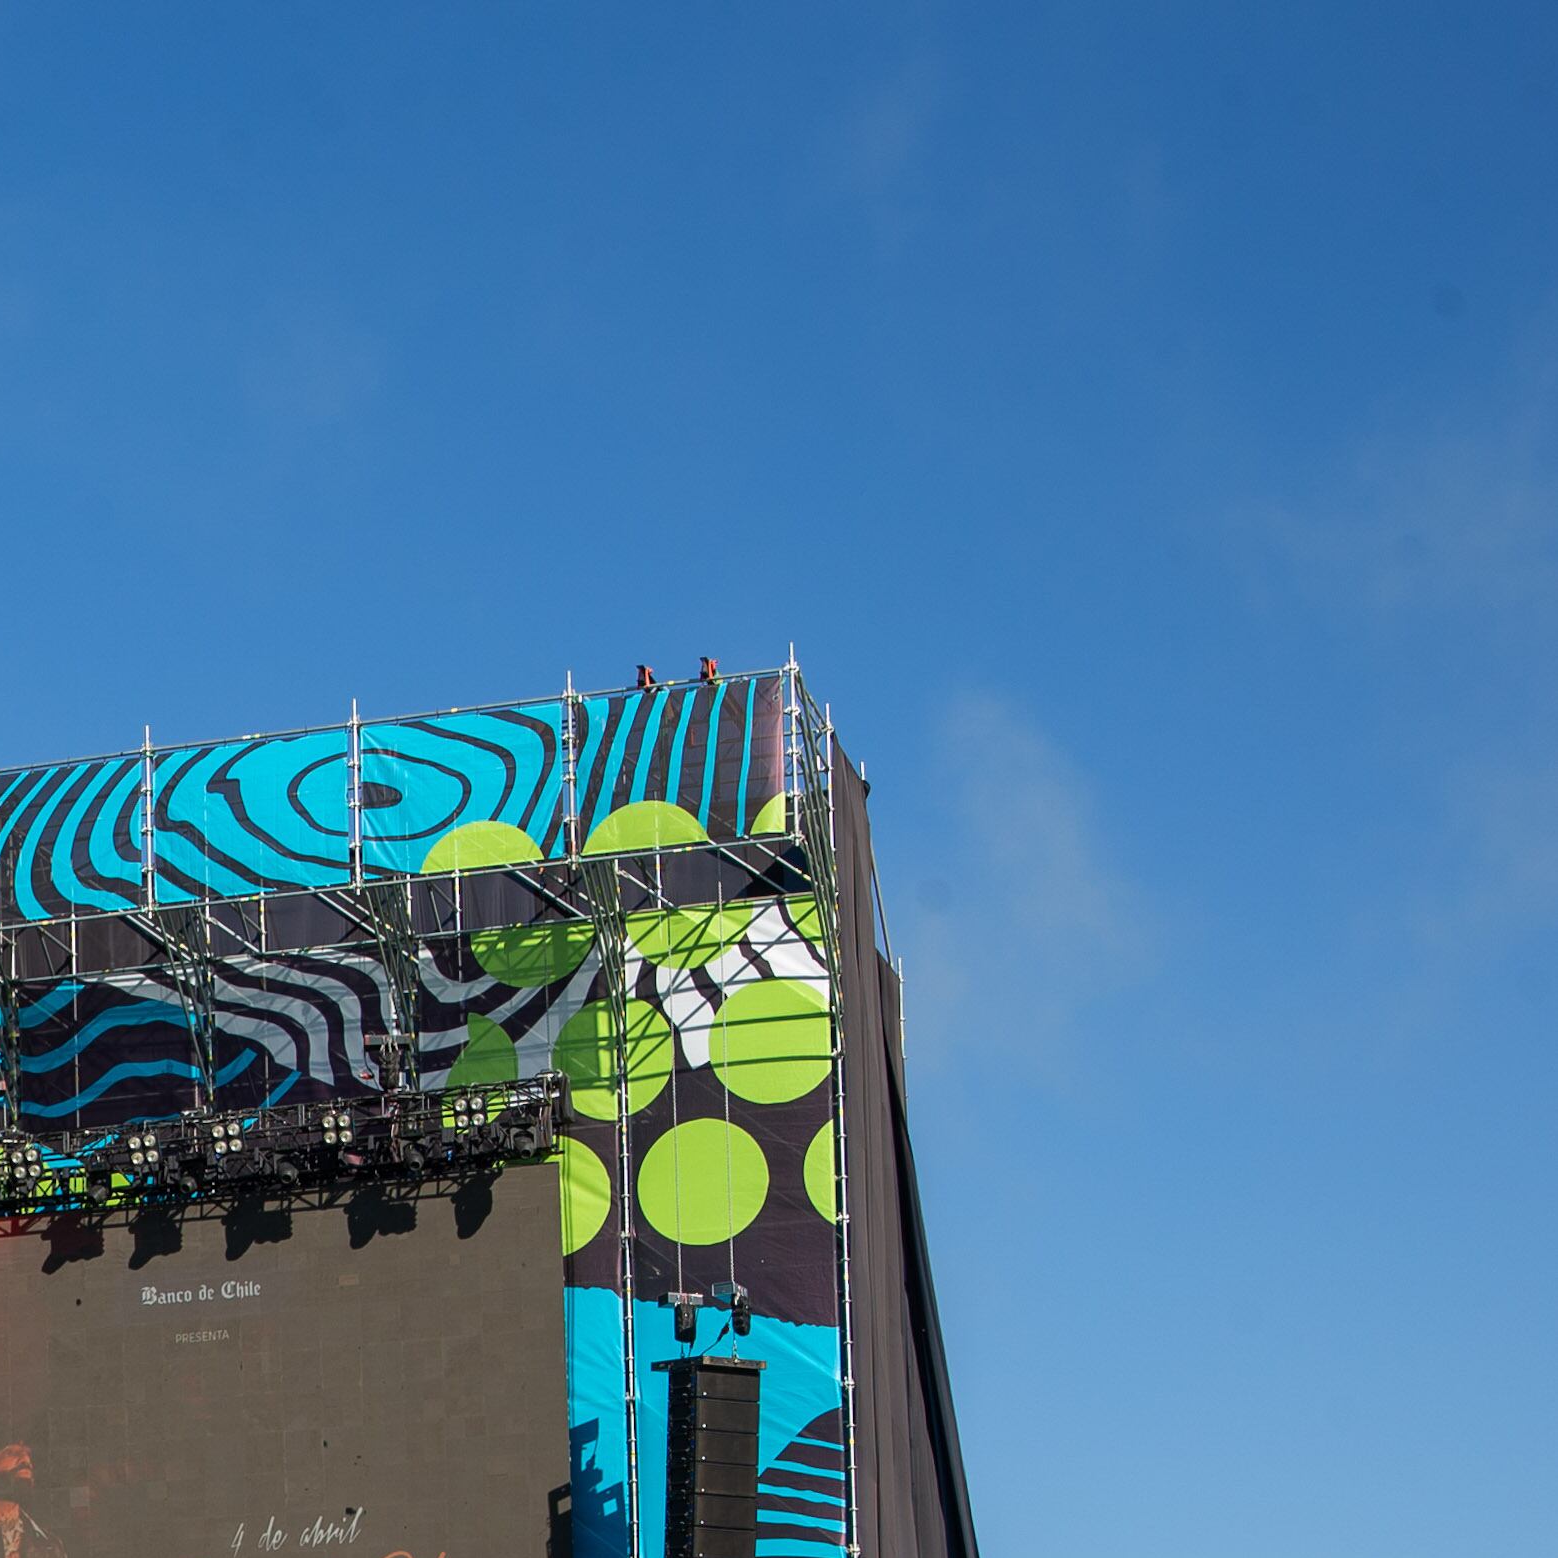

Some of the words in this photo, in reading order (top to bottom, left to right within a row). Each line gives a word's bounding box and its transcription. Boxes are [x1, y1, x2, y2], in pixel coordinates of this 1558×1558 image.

[140, 1286, 192, 1306] Banco
[198, 1284, 214, 1300] de
[221, 1281, 261, 1299] Chile
[175, 1330, 229, 1343] PRESENTA
[230, 1522, 244, 1557] 4
[257, 1516, 287, 1551] de
[299, 1506, 364, 1548] abril
